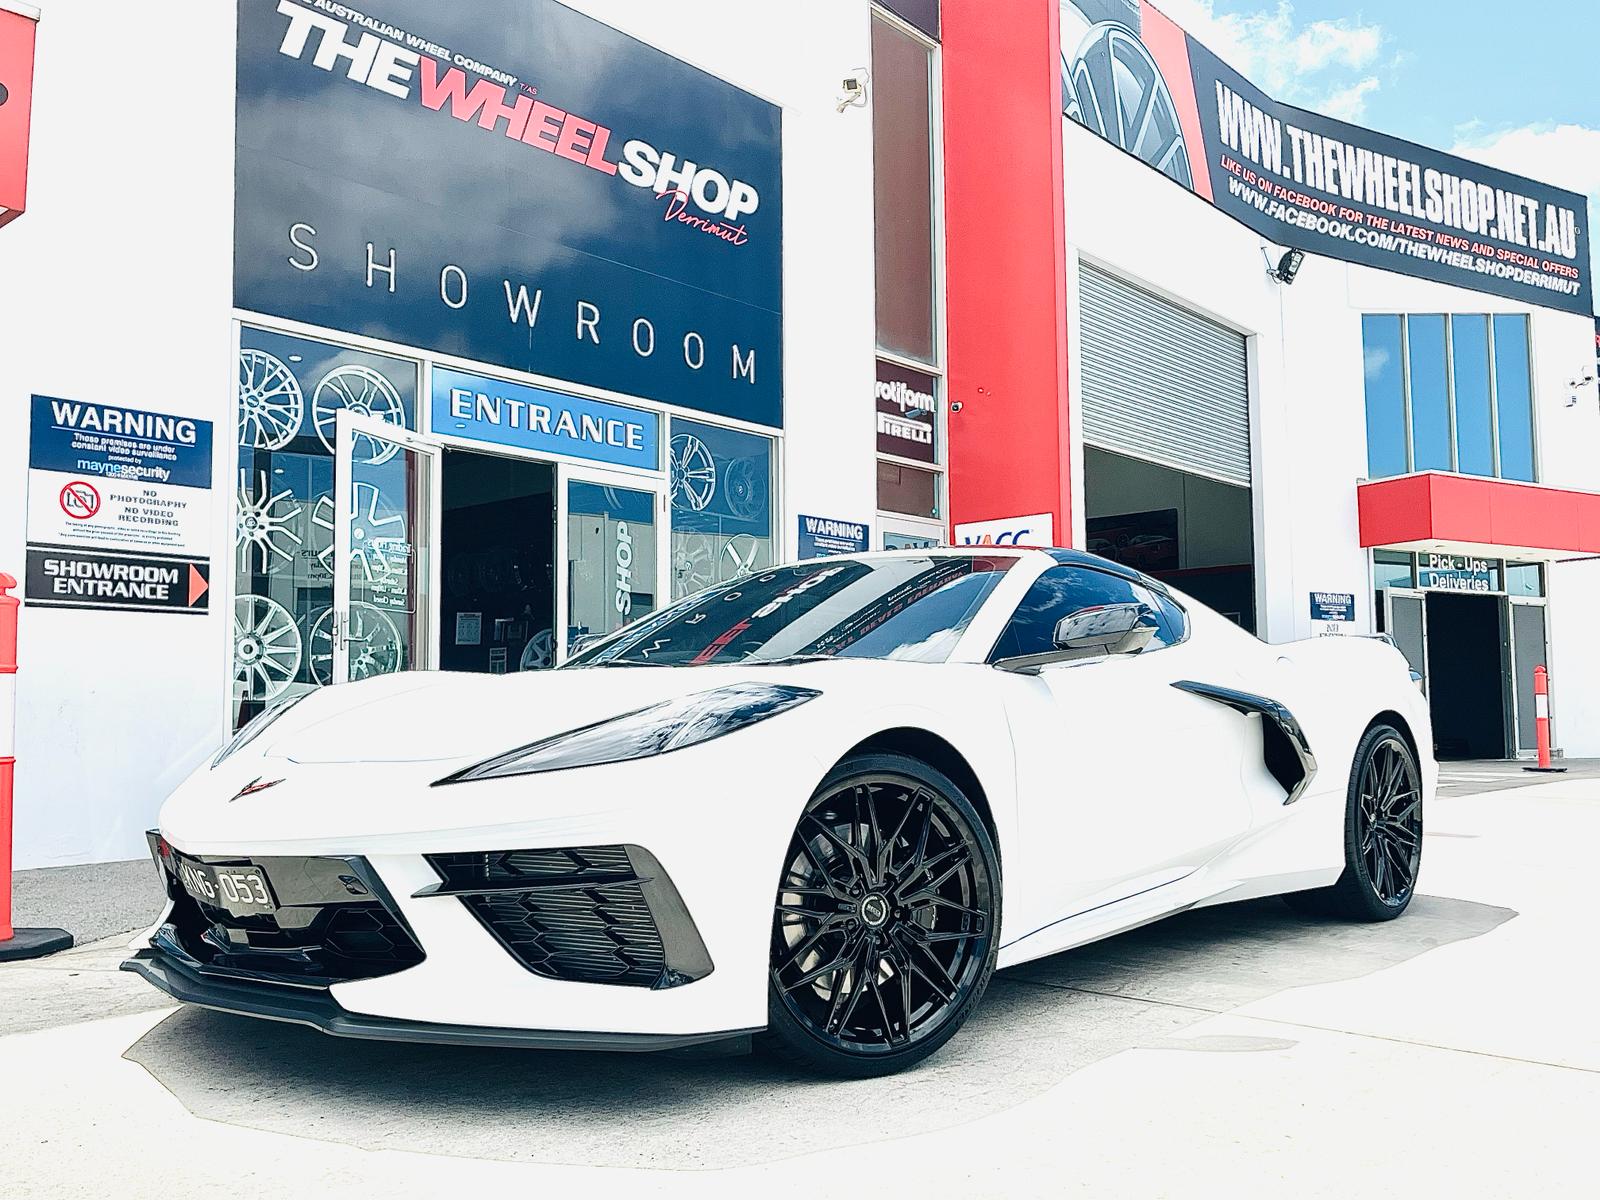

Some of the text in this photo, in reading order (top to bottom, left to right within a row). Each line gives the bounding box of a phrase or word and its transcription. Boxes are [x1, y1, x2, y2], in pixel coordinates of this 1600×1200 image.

[314, 0, 404, 41] AUSTRALIAN
[406, 33, 452, 61] WHEEL
[454, 54, 517, 87] COMPANY
[420, 56, 618, 176] WHEEL
[618, 139, 759, 220] SHOP
[1215, 79, 1577, 259] WWW.THEWHEELSHOP.NET.AU
[656, 189, 748, 246] Derrimut
[1220, 154, 1579, 279] LIKE US ON FACEBOOK FOR THE LATEST NEWS AND SPECIAL OFFERS
[1228, 176, 1581, 296] WWW.FACEBOOK.COM/THEWHEELSHOPDERRIMUT
[875, 381, 936, 412] rotiform
[51, 401, 196, 444] WARNING
[450, 388, 645, 450] ENTRANCE
[877, 412, 932, 444] PIRELLI
[108, 445, 130, 455] video
[110, 494, 187, 508] PHOTOGRAPHY
[142, 508, 174, 518] VIDEO
[118, 515, 179, 526] RECORDING
[806, 517, 863, 540] WARNING
[44, 559, 179, 583] SHOWROOM
[616, 521, 632, 616] SHOP
[1429, 573, 1489, 591] Deliveries
[53, 578, 169, 600] ENTRANCE
[1314, 593, 1351, 605] WARNING
